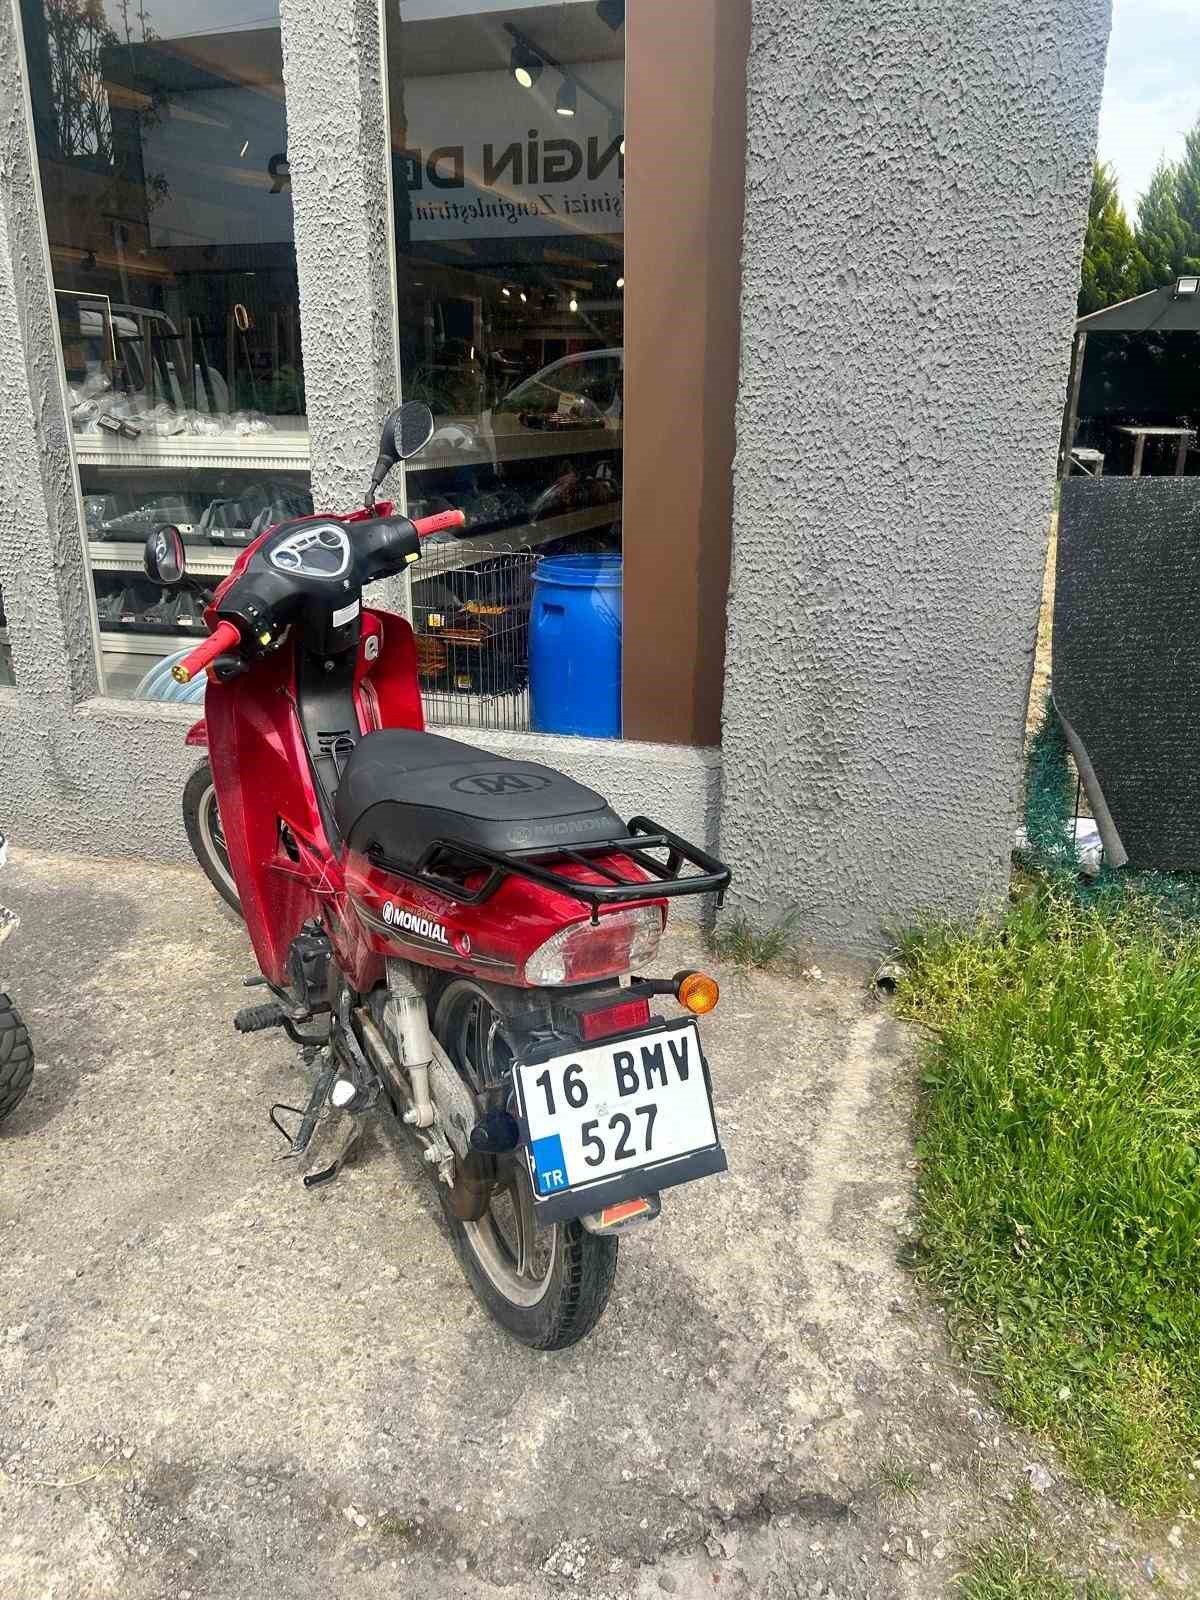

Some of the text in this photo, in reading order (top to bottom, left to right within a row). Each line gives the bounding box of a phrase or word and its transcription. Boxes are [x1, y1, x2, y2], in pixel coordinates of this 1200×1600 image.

[393, 908, 449, 944] MONDIAL
[536, 1037, 690, 1115] 16 BMV
[581, 1103, 658, 1167] 527
[542, 1169, 564, 1188] TR
